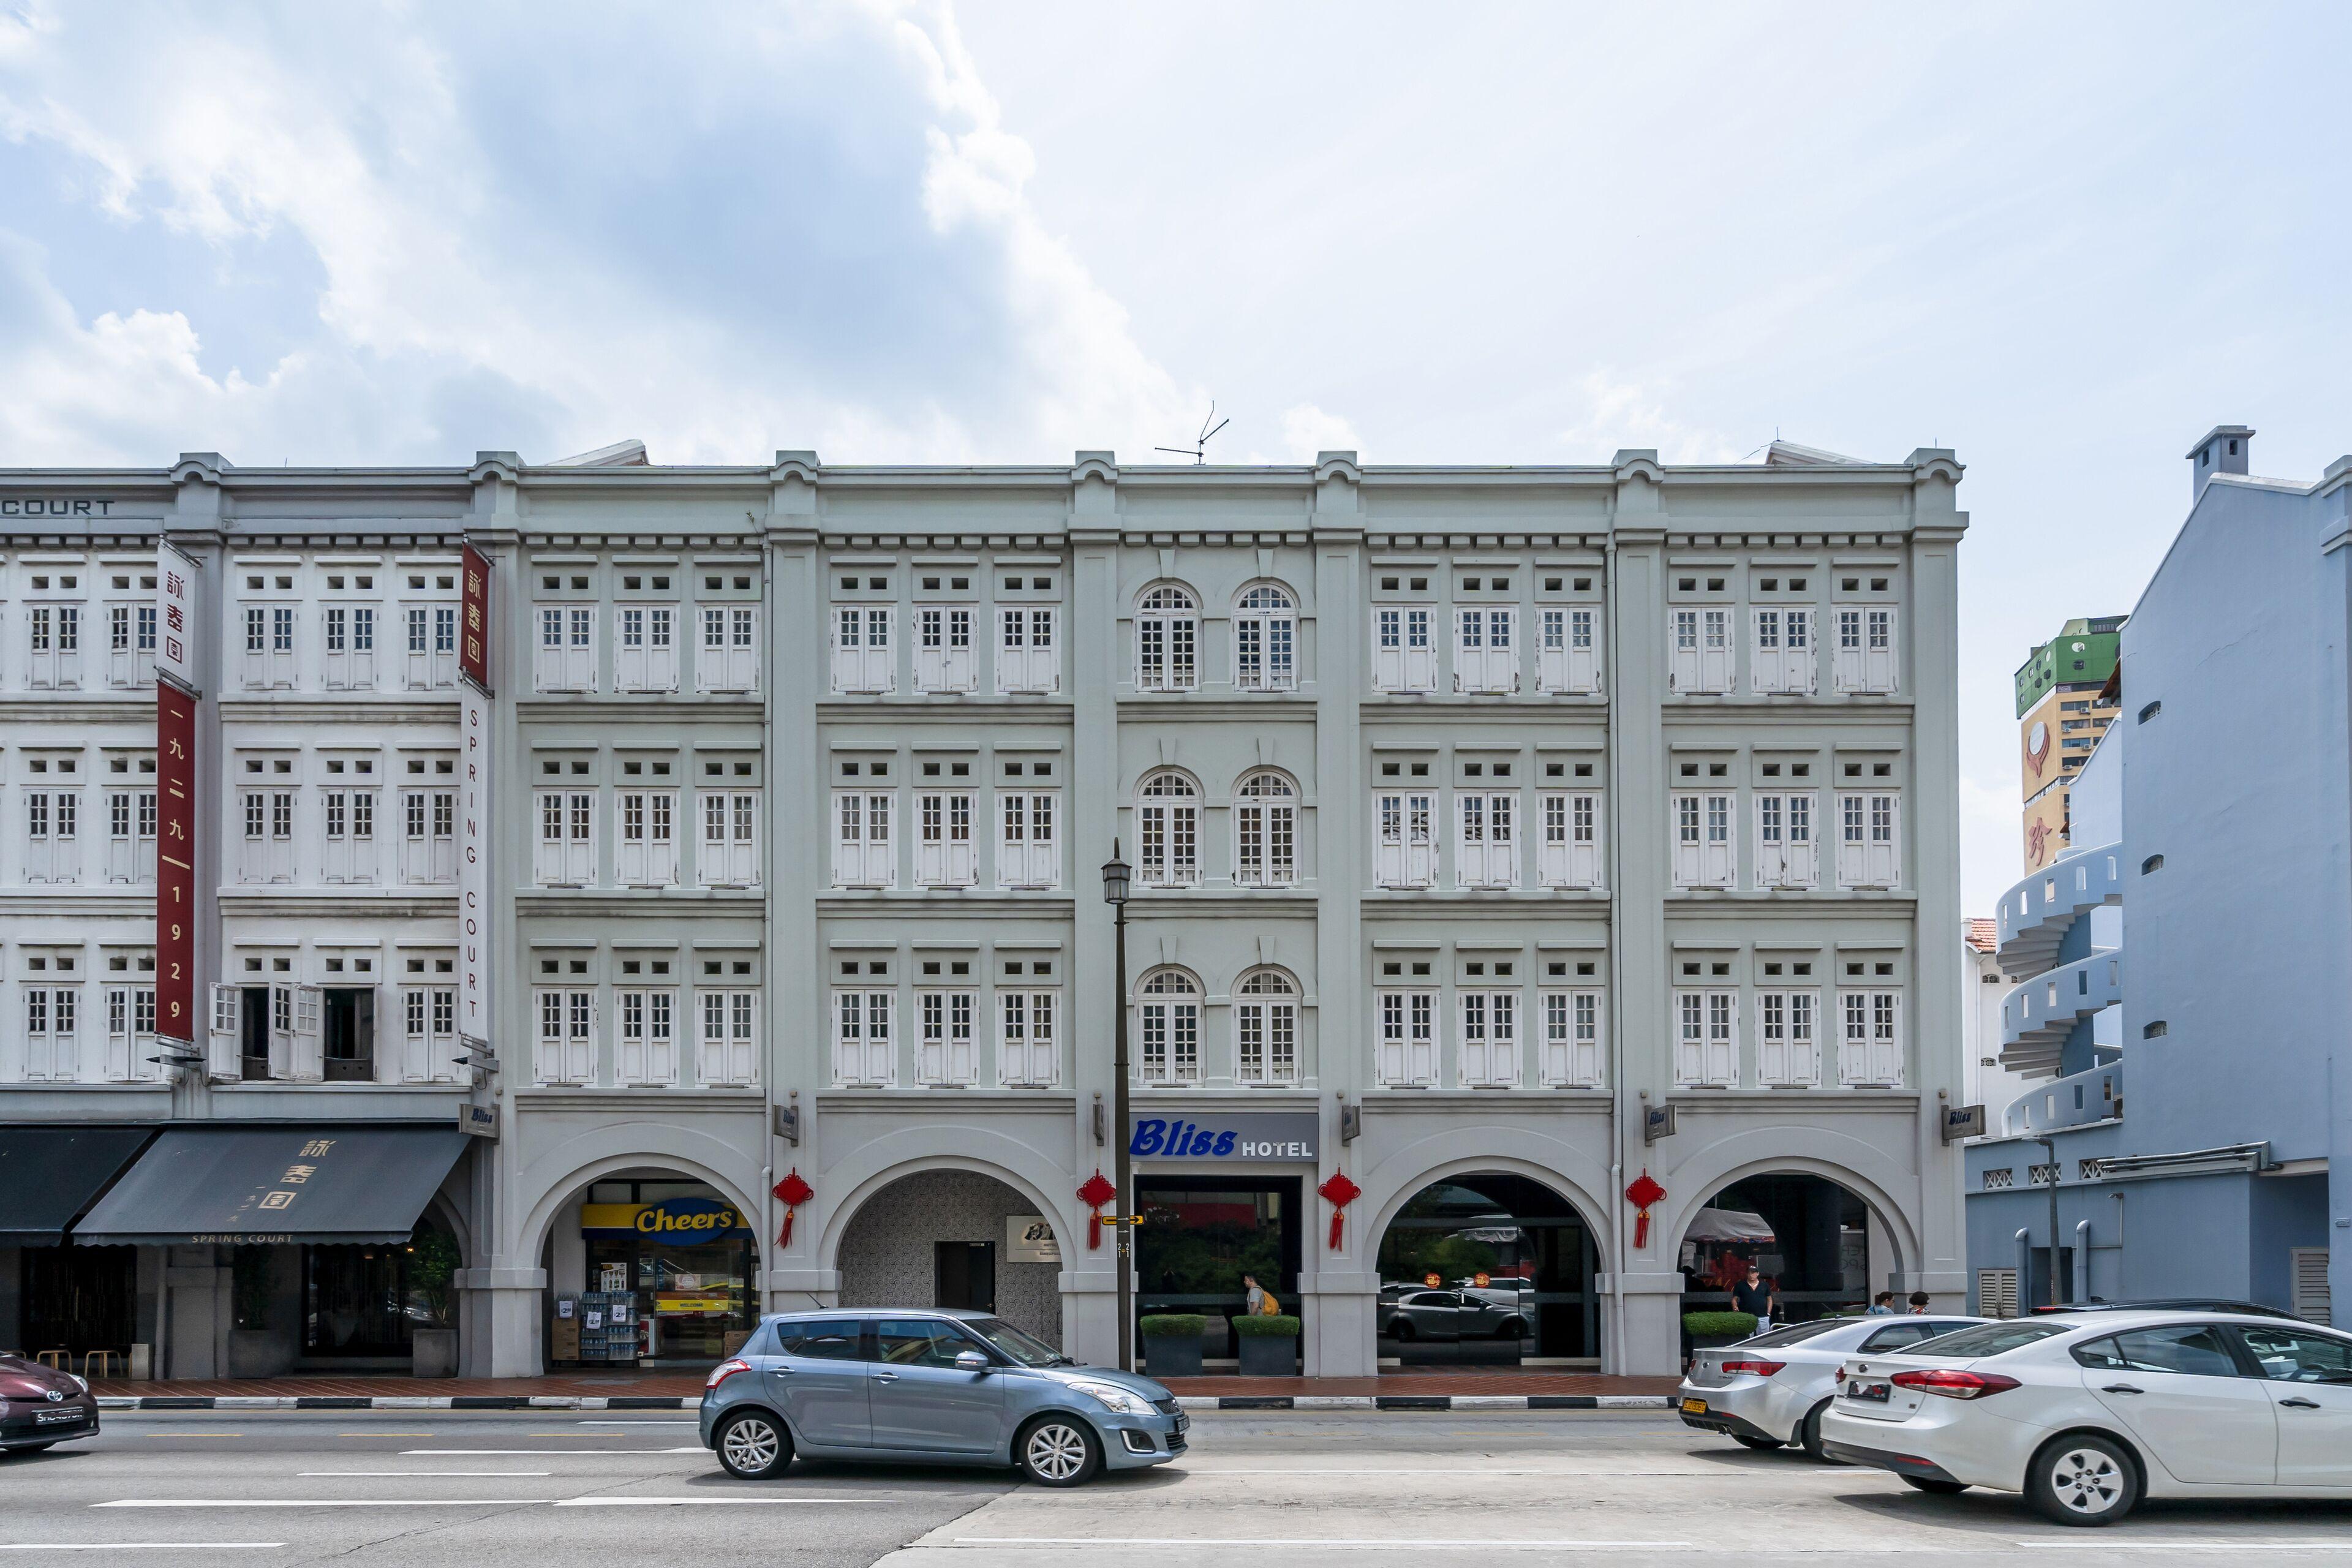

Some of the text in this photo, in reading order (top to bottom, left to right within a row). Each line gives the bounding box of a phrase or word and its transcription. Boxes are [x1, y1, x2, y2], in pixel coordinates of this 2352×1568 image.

[2, 500, 115, 515] COURT
[467, 709, 478, 1017] SPRING COURT
[170, 886, 181, 1018] 1929
[1949, 1111, 1972, 1125] Bliss
[1129, 1119, 1313, 1156] Bliss HOTEL
[637, 1208, 732, 1232] Cheers
[192, 1235, 242, 1243] SPRING
